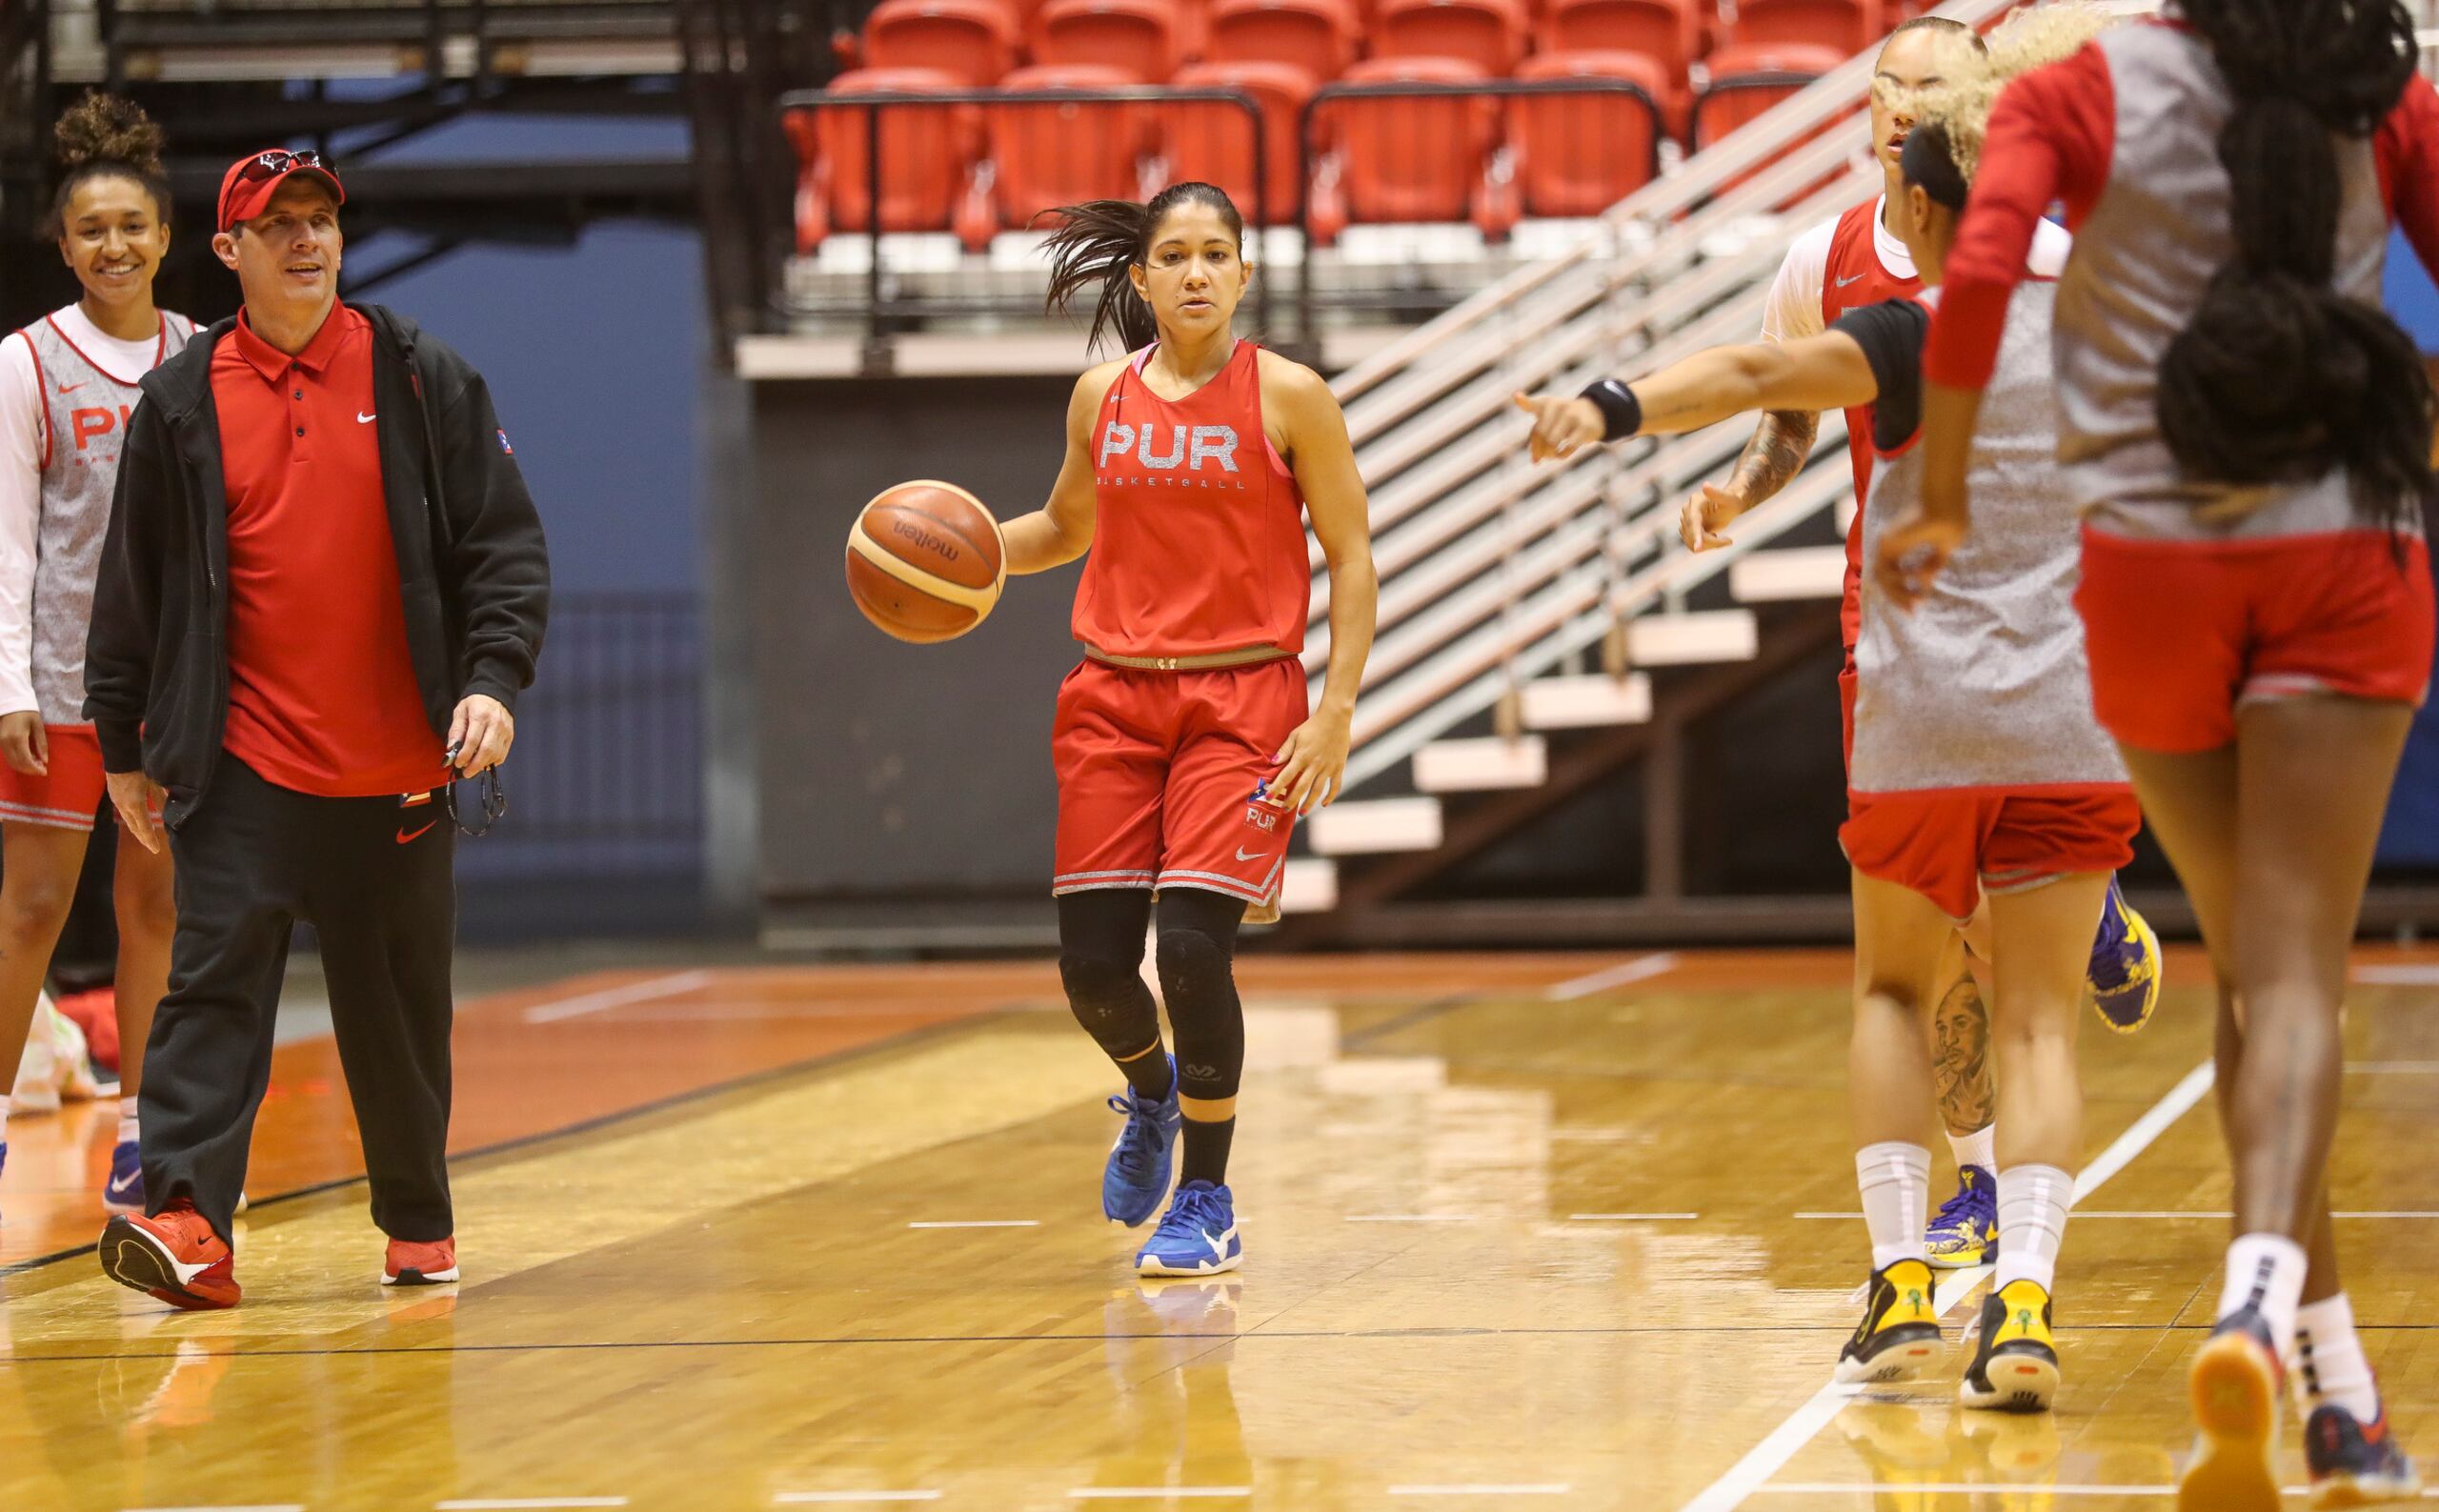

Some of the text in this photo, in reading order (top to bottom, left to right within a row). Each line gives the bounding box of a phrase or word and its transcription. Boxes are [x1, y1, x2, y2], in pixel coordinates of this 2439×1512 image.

[1100, 421, 1240, 473] PUR
[894, 521, 958, 561] molten
[1246, 807, 1277, 832] PUR
